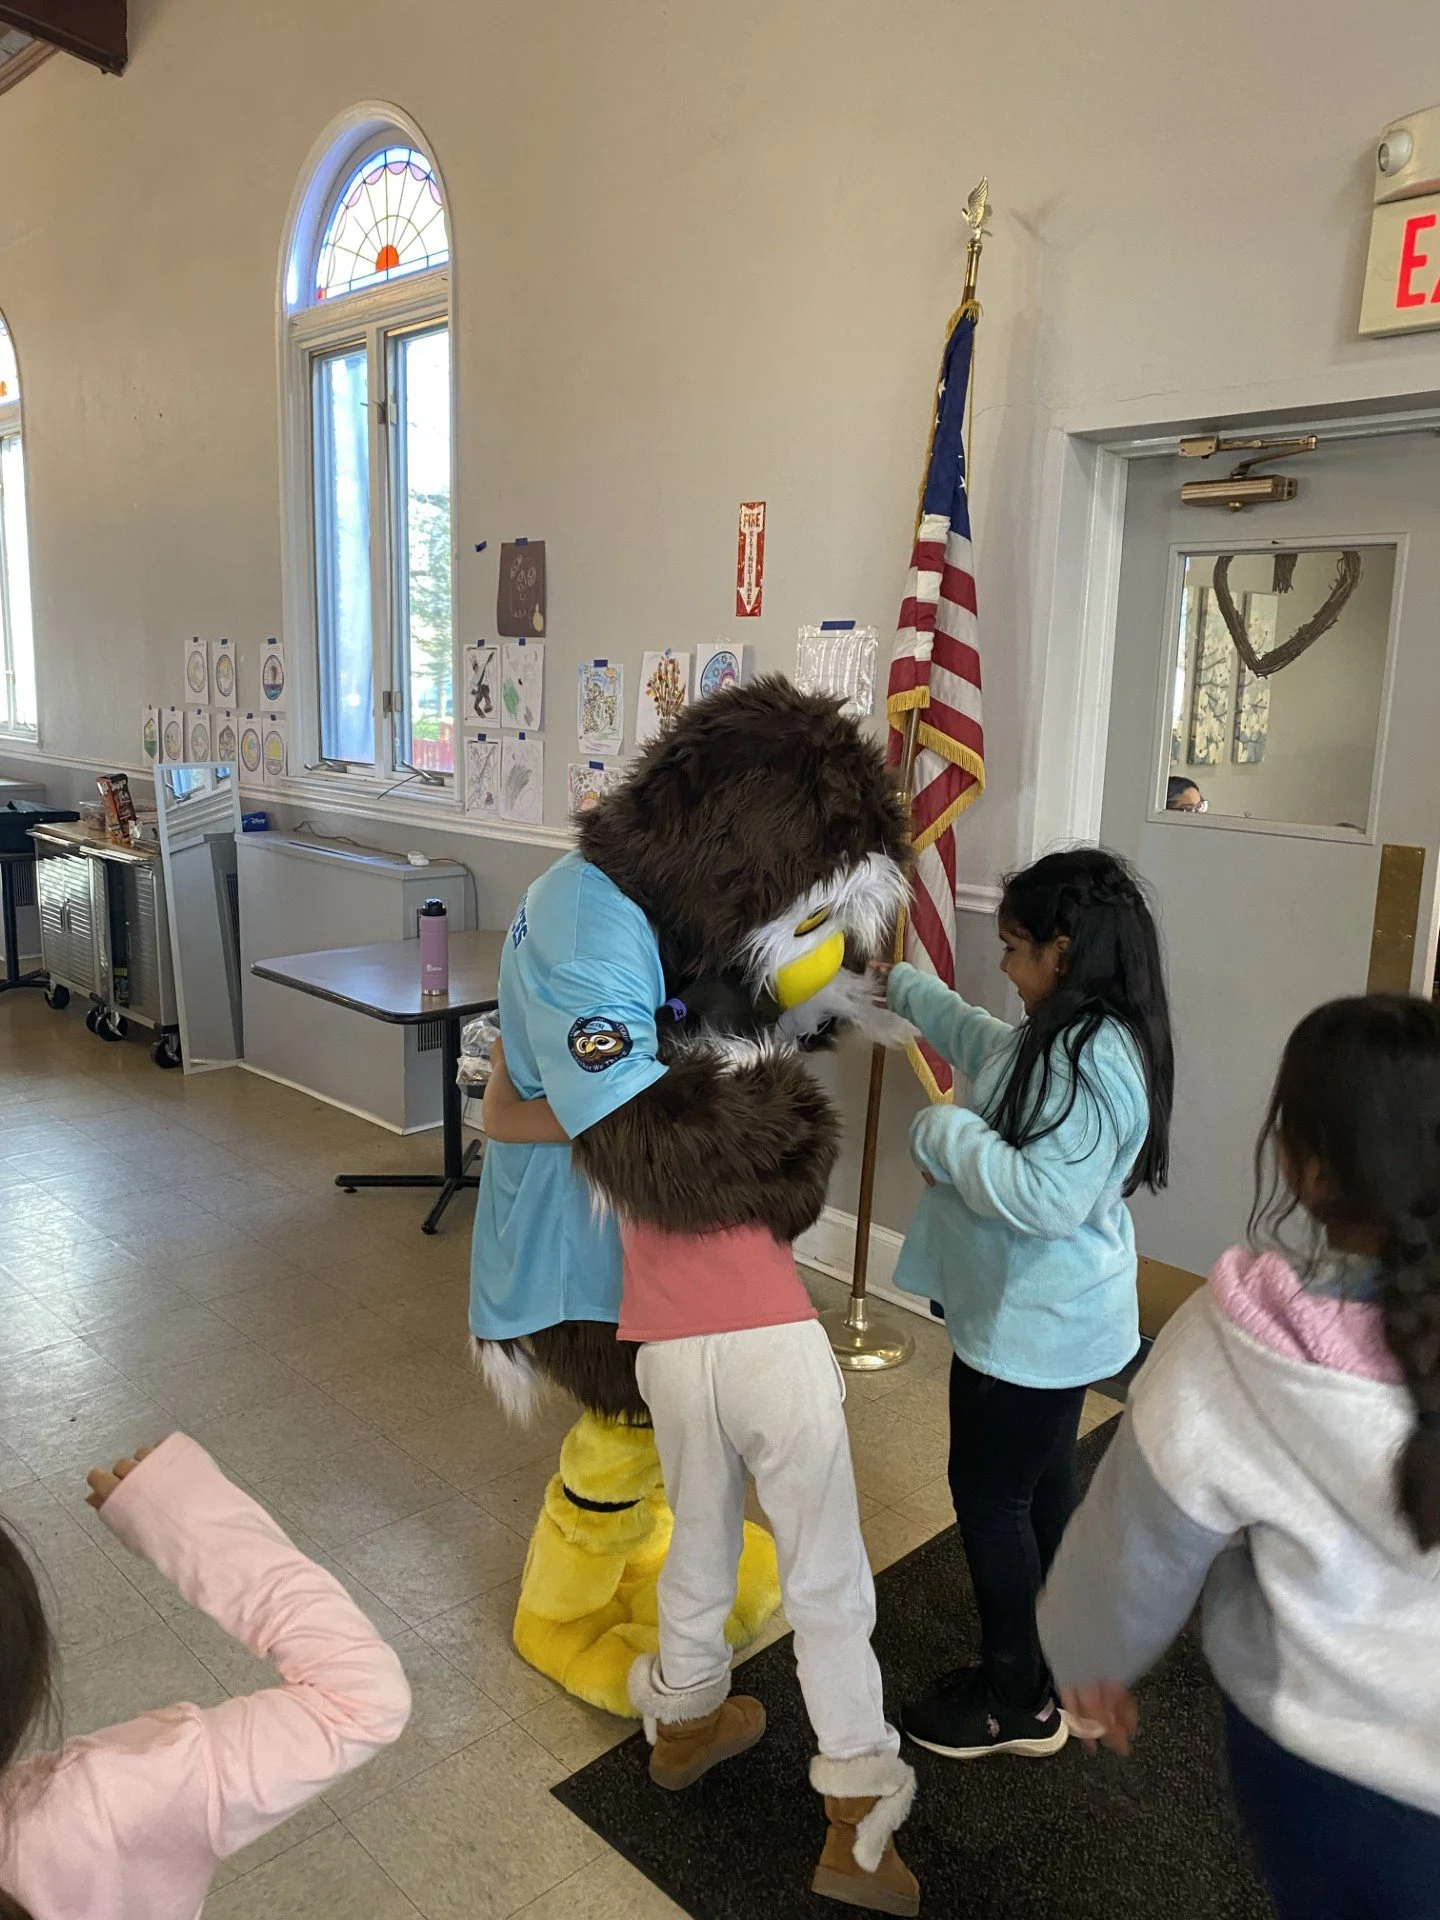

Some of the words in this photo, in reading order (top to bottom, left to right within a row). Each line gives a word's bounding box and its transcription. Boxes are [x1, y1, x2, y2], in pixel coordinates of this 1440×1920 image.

[1396, 214, 1440, 309] E
[743, 512, 761, 529] FIRE
[746, 530, 755, 606] EXTINGUISHER
